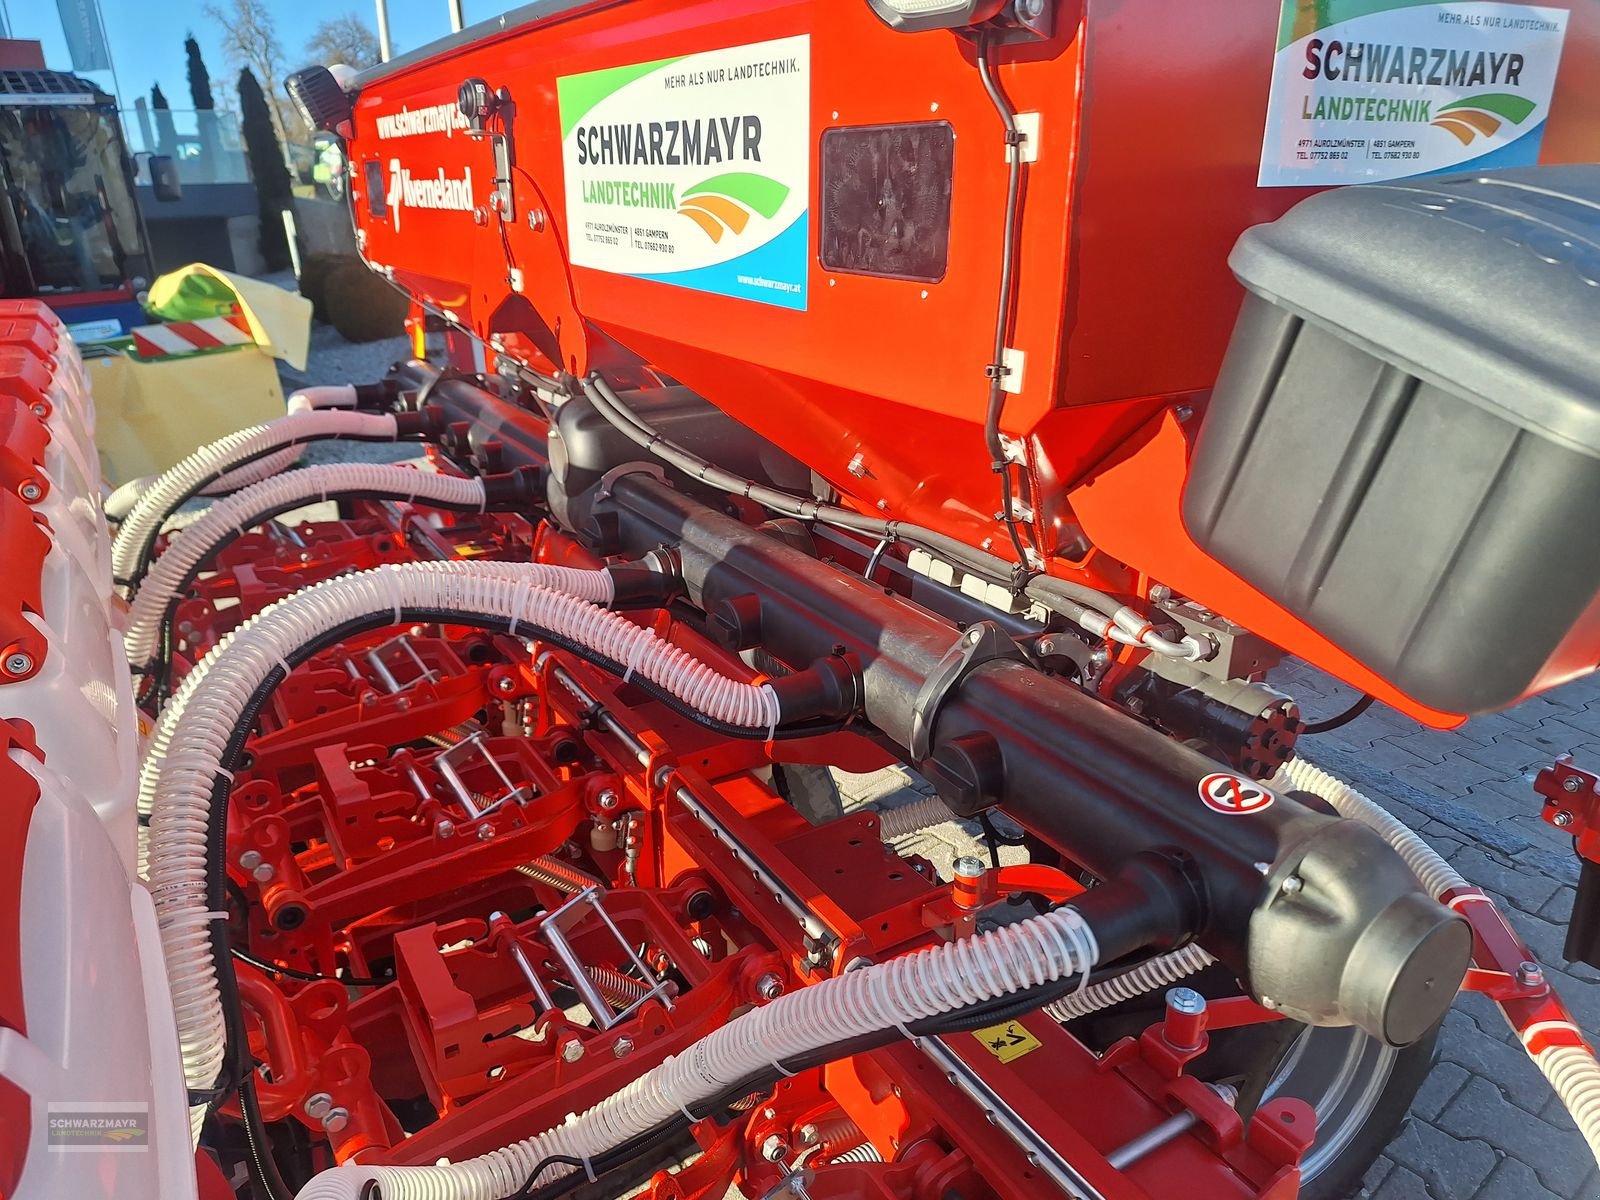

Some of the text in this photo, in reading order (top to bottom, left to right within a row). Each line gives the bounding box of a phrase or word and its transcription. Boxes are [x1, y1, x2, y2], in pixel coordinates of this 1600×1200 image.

[1438, 12, 1461, 24] MEHR
[1463, 14, 1481, 26] ALS
[1483, 16, 1500, 28] NUR
[664, 57, 800, 89] MEHR ALS NUR LANDTECHNIK.
[1302, 38, 1524, 87] SCHWARZMAYR
[1301, 95, 1432, 123] LANDTECHNIK
[577, 115, 762, 166] SCHWARZMAYR
[1298, 139, 1312, 148] 4971
[1387, 140, 1415, 148] GAMPERN
[402, 166, 474, 211] Kverneland
[582, 180, 677, 210] LANDTECHNIK
[646, 229, 669, 240] GAMPERN
[737, 275, 801, 293] www.schwarzmayr.at
